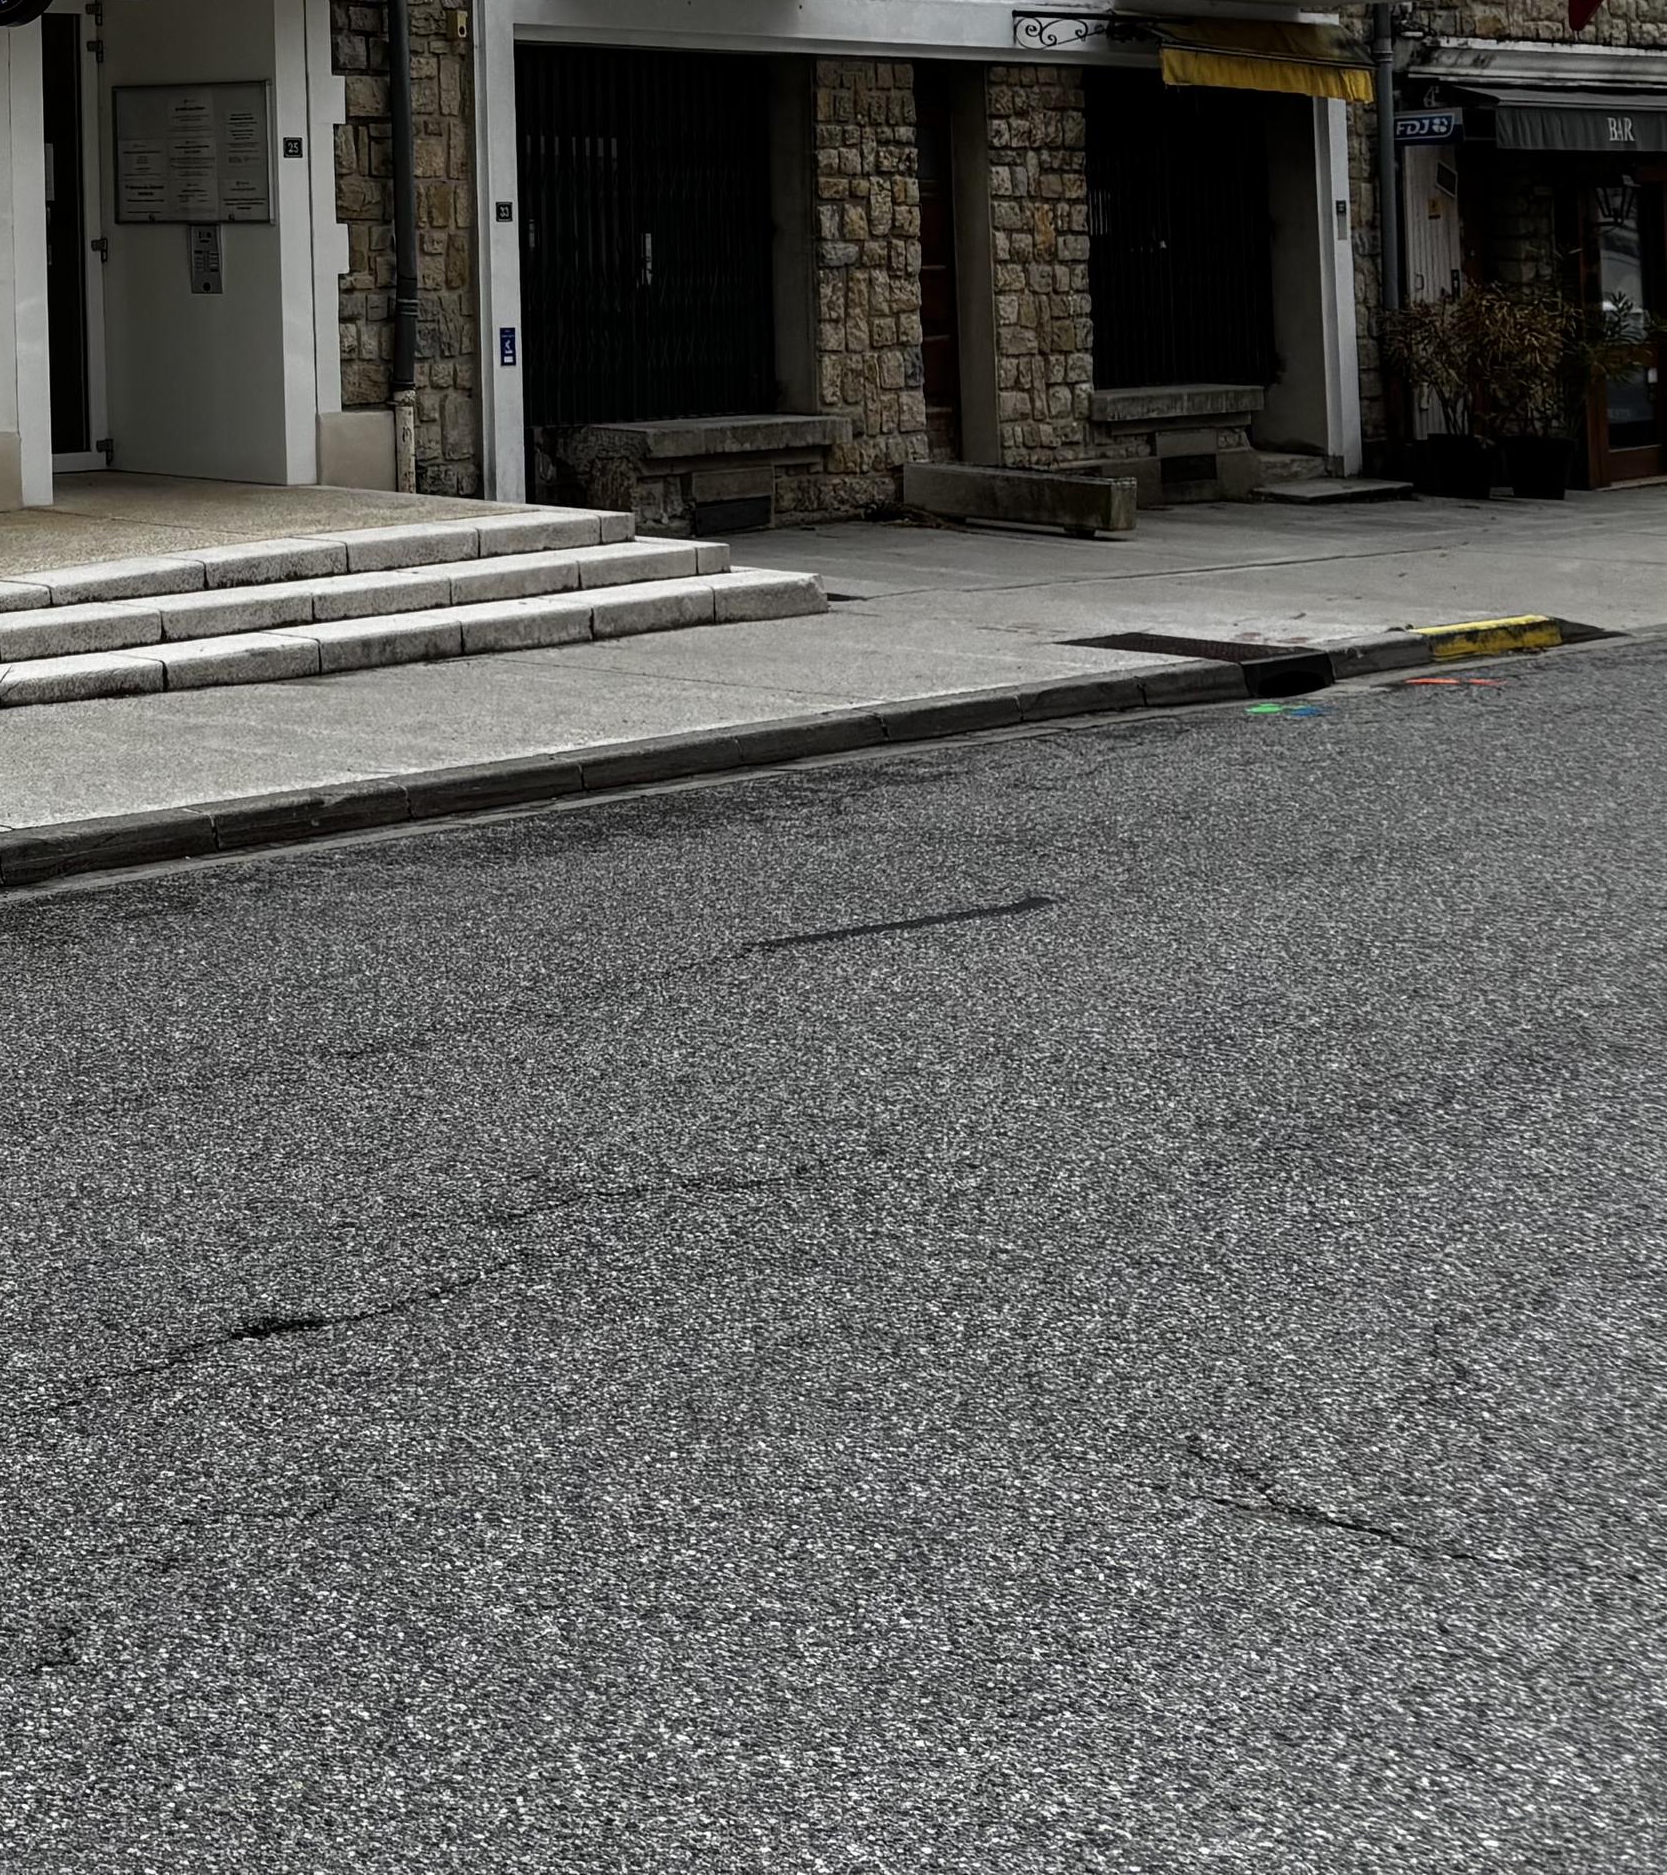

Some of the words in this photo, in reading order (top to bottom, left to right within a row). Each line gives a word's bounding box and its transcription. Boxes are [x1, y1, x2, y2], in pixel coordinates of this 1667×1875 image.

[1395, 119, 1429, 135] FDJ
[1607, 117, 1635, 141] BAR
[287, 141, 299, 153] 25
